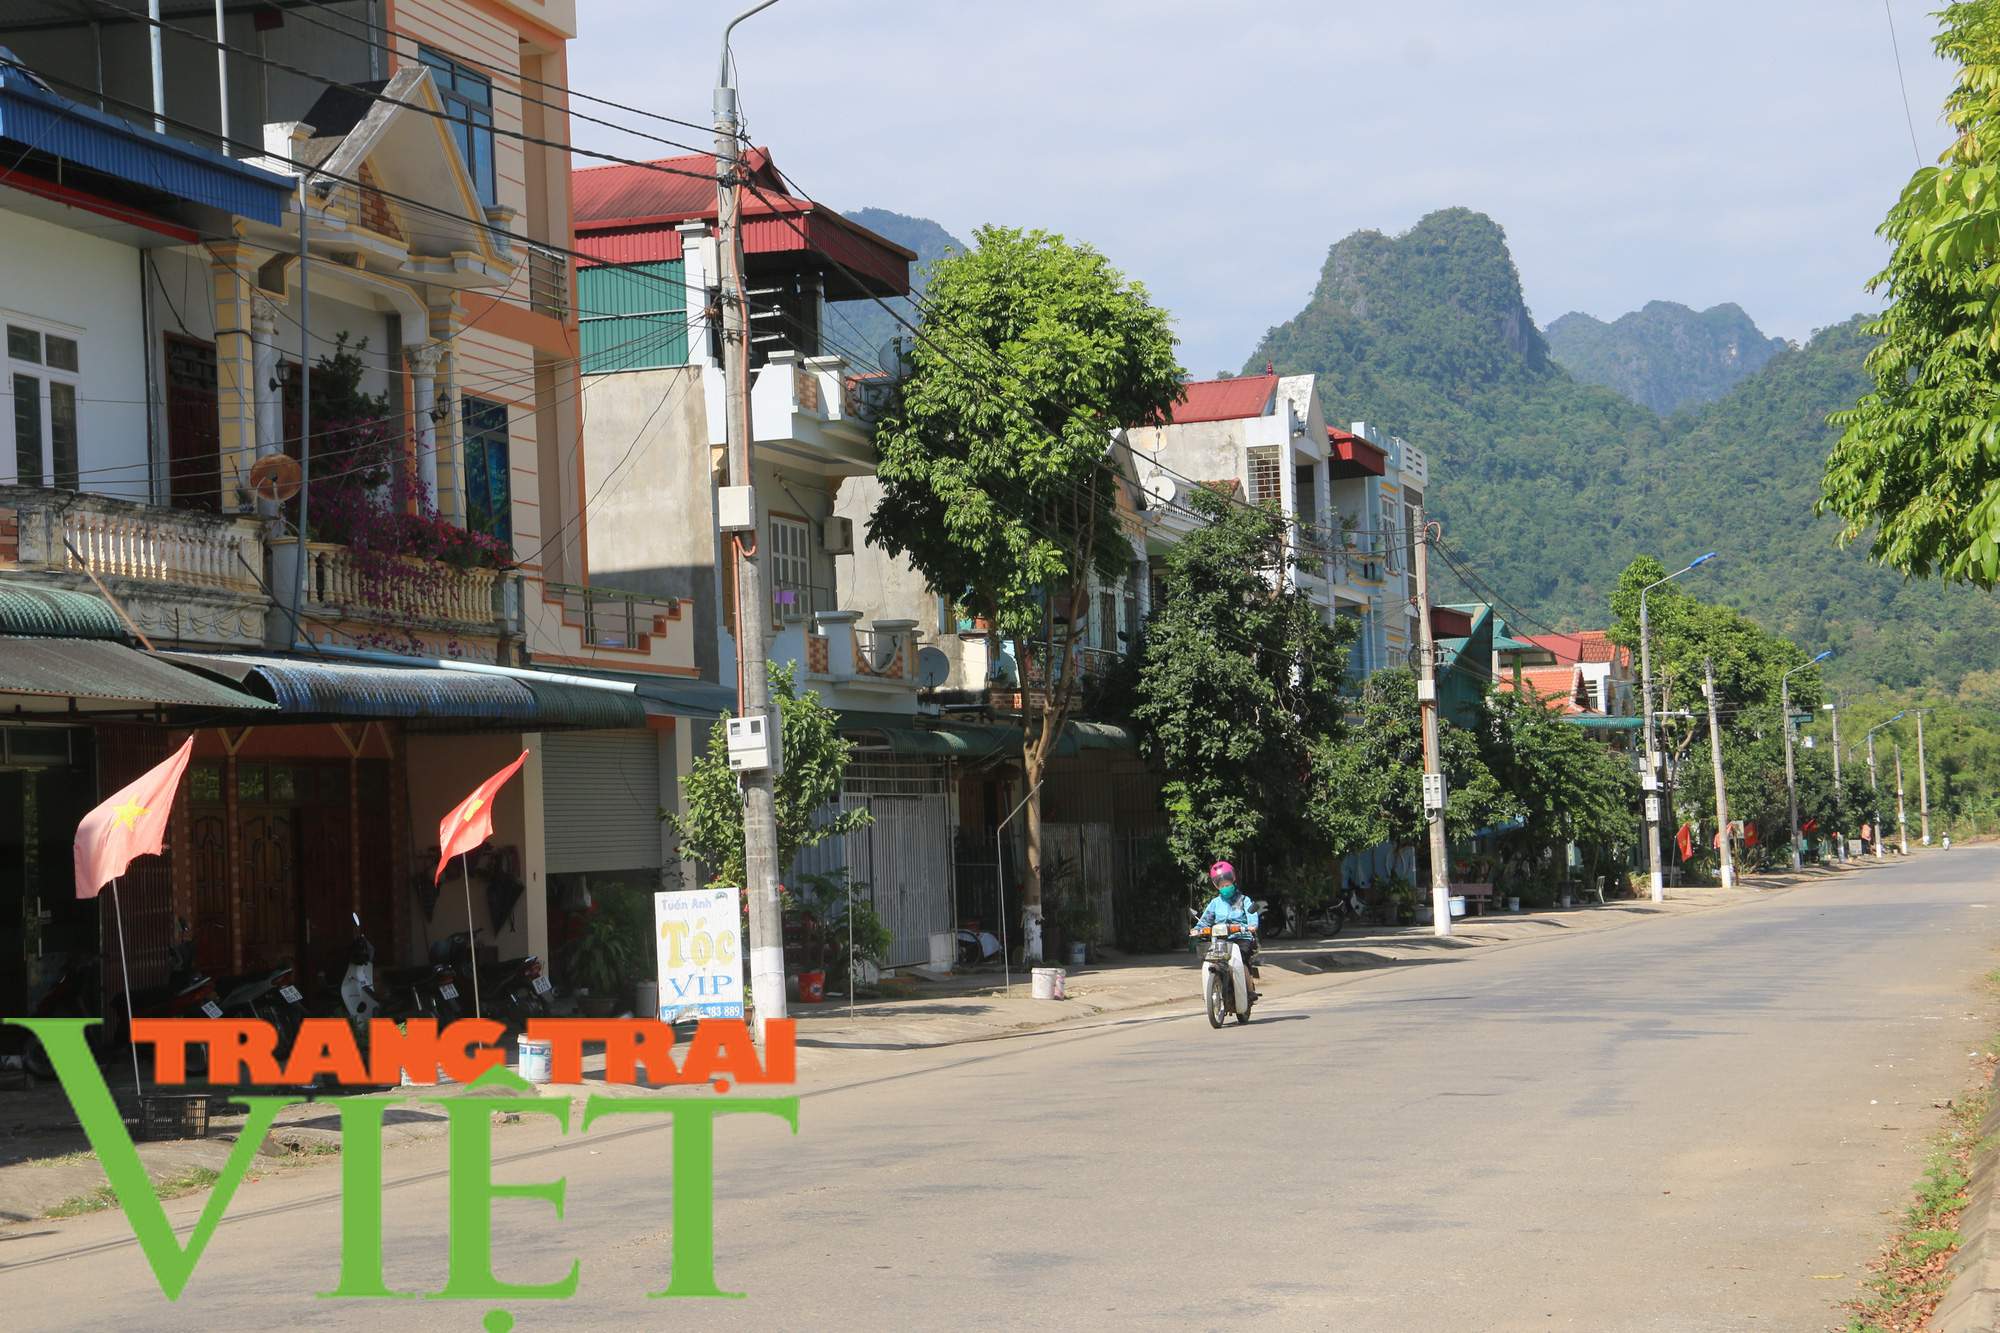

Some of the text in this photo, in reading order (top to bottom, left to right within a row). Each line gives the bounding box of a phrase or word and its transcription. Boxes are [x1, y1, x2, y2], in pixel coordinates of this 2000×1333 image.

[691, 897, 712, 909] Anh
[661, 917, 736, 969] Tóc
[669, 973, 733, 997] VIP
[706, 1006, 722, 1017] 383
[724, 1005, 740, 1017] 889
